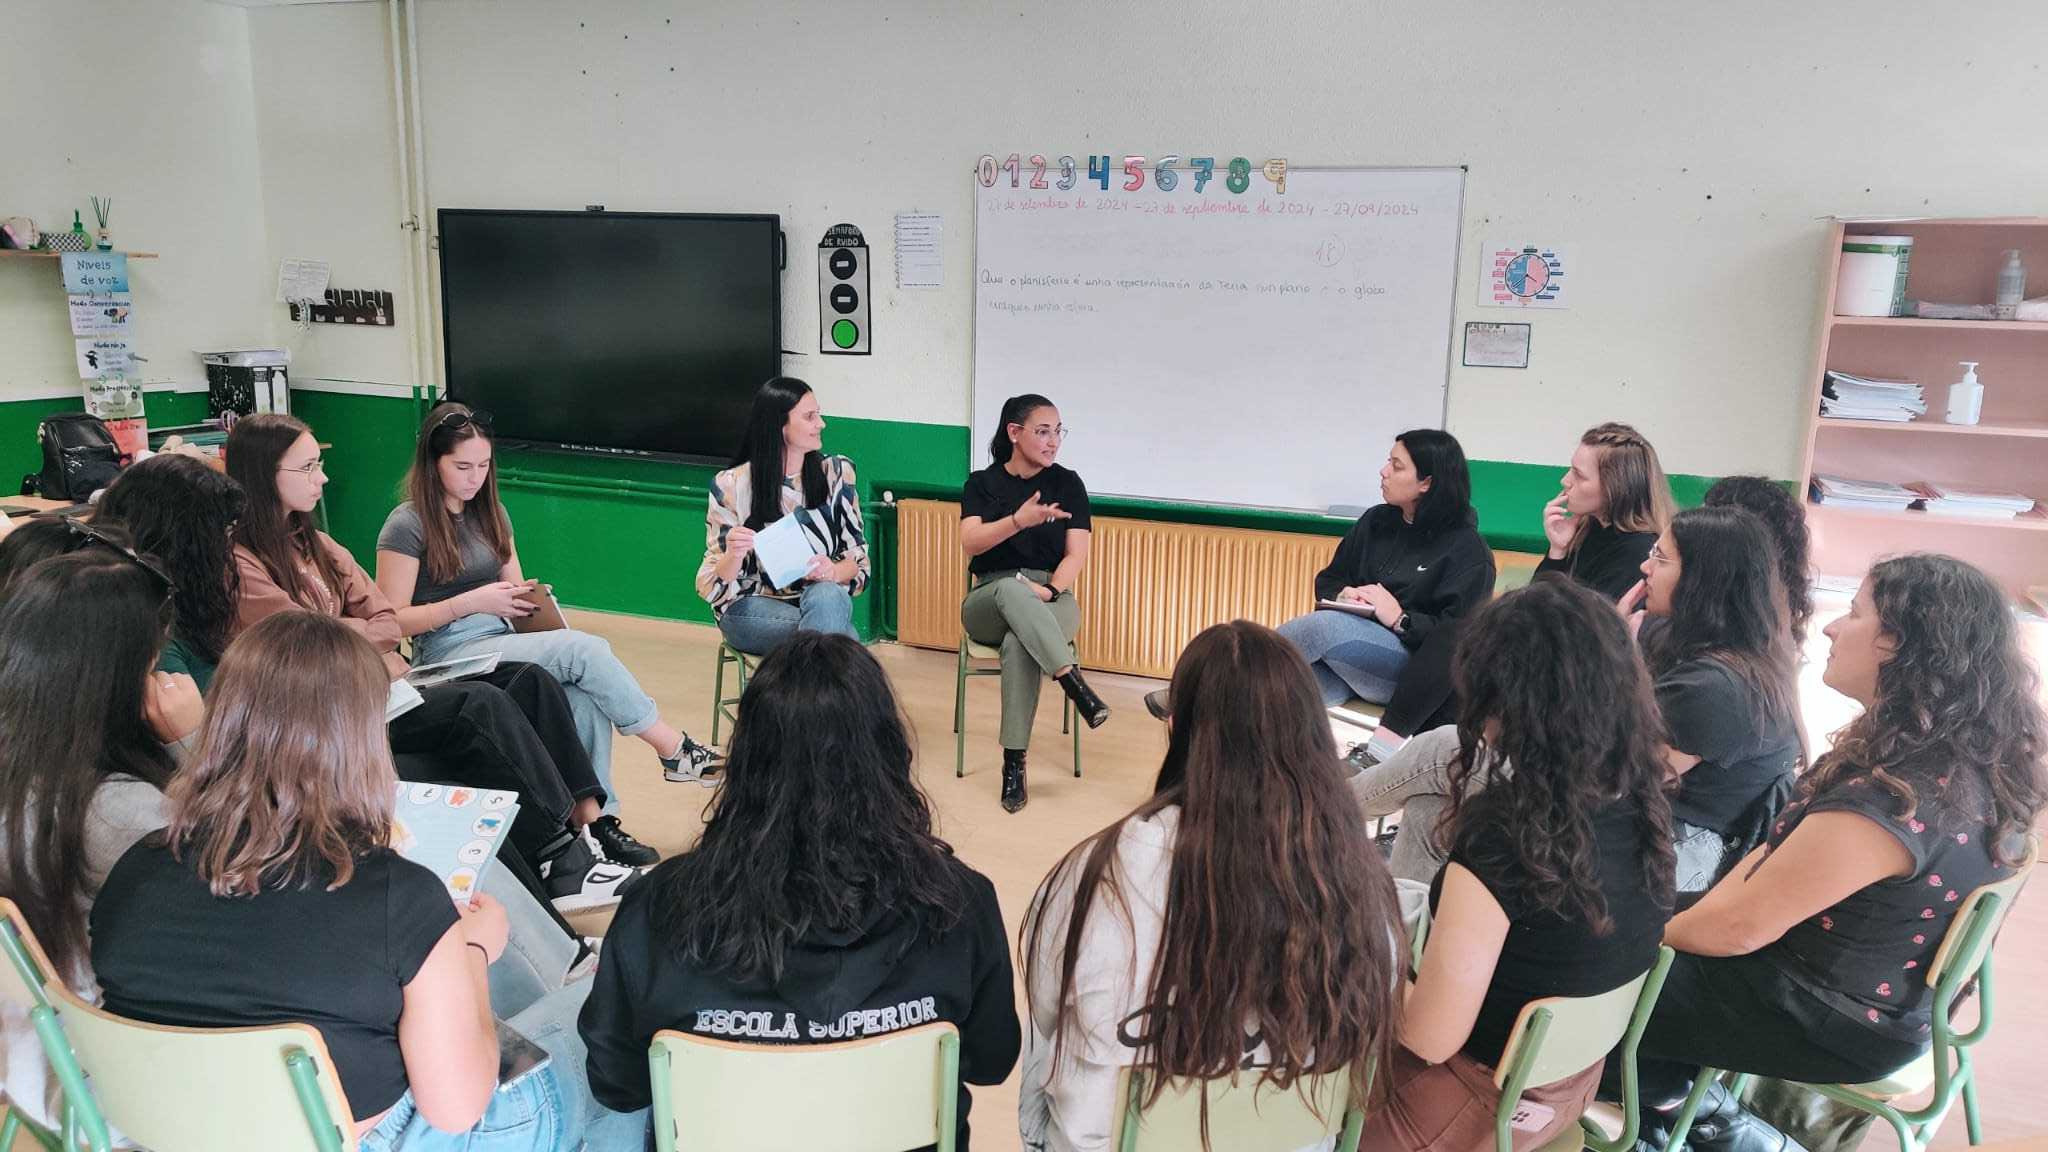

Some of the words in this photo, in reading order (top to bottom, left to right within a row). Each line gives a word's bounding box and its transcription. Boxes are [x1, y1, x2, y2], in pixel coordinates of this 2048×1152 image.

[977, 154, 998, 187] 0
[1003, 153, 1020, 187] 1
[1030, 155, 1048, 189] 2
[1056, 155, 1077, 191] 3
[1088, 155, 1110, 190] 4
[1123, 155, 1145, 191] 5
[1155, 155, 1180, 192] 6
[1190, 157, 1215, 193] 7
[1226, 157, 1251, 194] 8
[1075, 197, 1088, 209] de
[1096, 199, 1128, 211] 2024
[1256, 198, 1273, 214] de
[1278, 202, 1315, 217] 2024
[80, 275, 95, 285] de
[98, 276, 119, 285] voz
[693, 1009, 800, 1039] ESCOLA
[808, 996, 938, 1038] SUPERIOR
